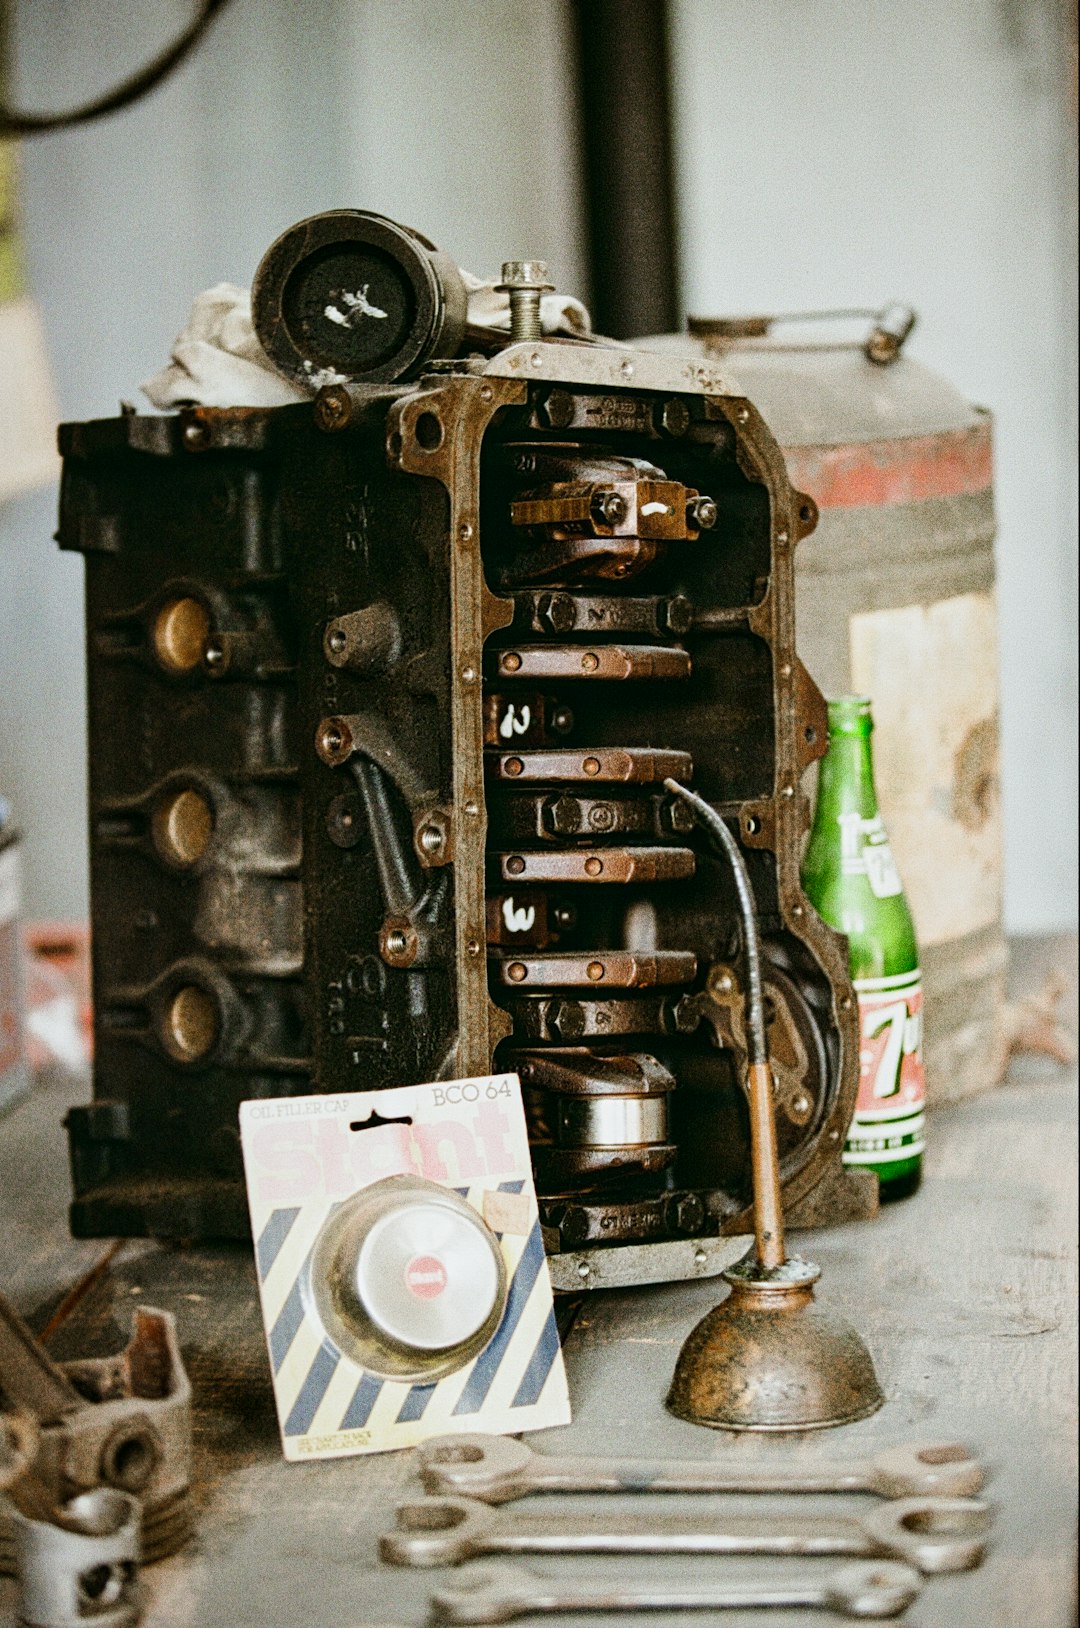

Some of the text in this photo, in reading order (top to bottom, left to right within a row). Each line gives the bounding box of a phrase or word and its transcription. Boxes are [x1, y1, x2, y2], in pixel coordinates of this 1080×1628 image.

[432, 1080, 512, 1106] BCO 64
[249, 1106, 275, 1120] OIL
[324, 1099, 350, 1113] CAP
[252, 1101, 516, 1200] Stant
